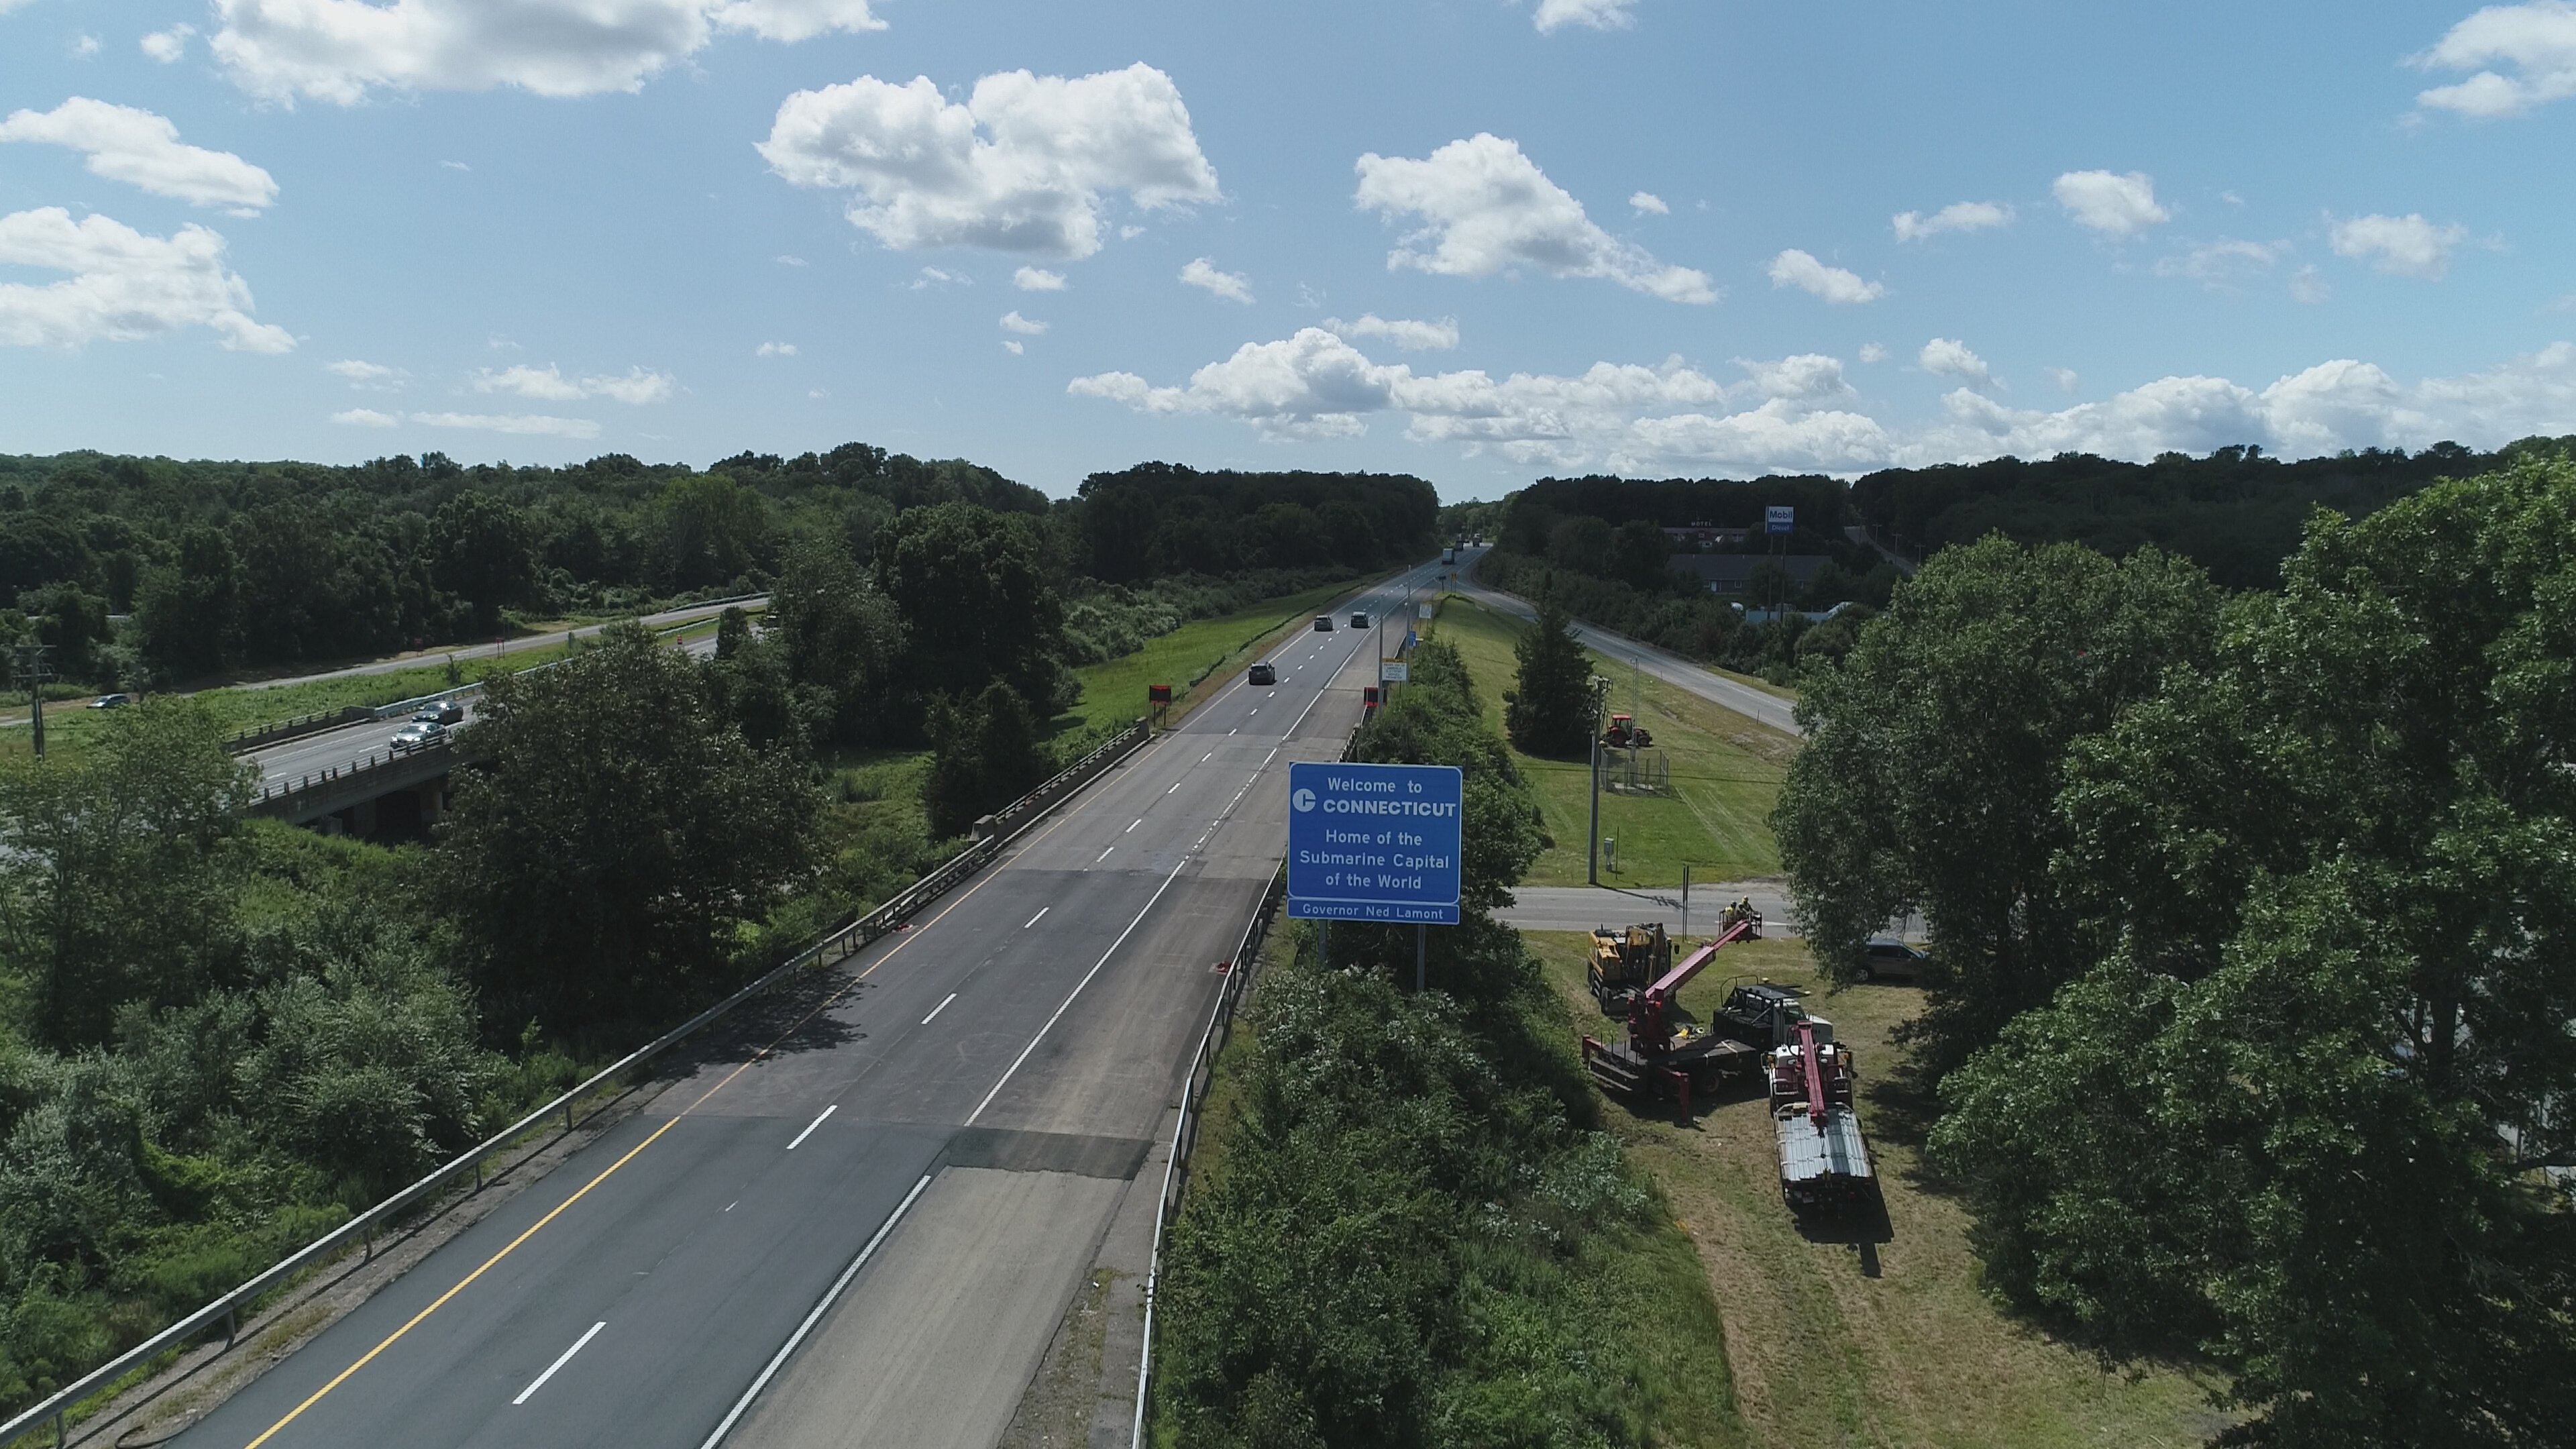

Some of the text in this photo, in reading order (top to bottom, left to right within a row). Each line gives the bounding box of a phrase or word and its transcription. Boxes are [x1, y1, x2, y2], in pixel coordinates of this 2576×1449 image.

[1770, 511, 1792, 519] Mobil
[1328, 777, 1421, 793] Welcome to
[1324, 799, 1456, 817] CONNECTICUT
[1326, 829, 1422, 846] Home of the
[1300, 850, 1449, 871] Submarine Capital
[1326, 873, 1421, 889] of the World
[1303, 904, 1443, 919] Governor Ned Lamont
